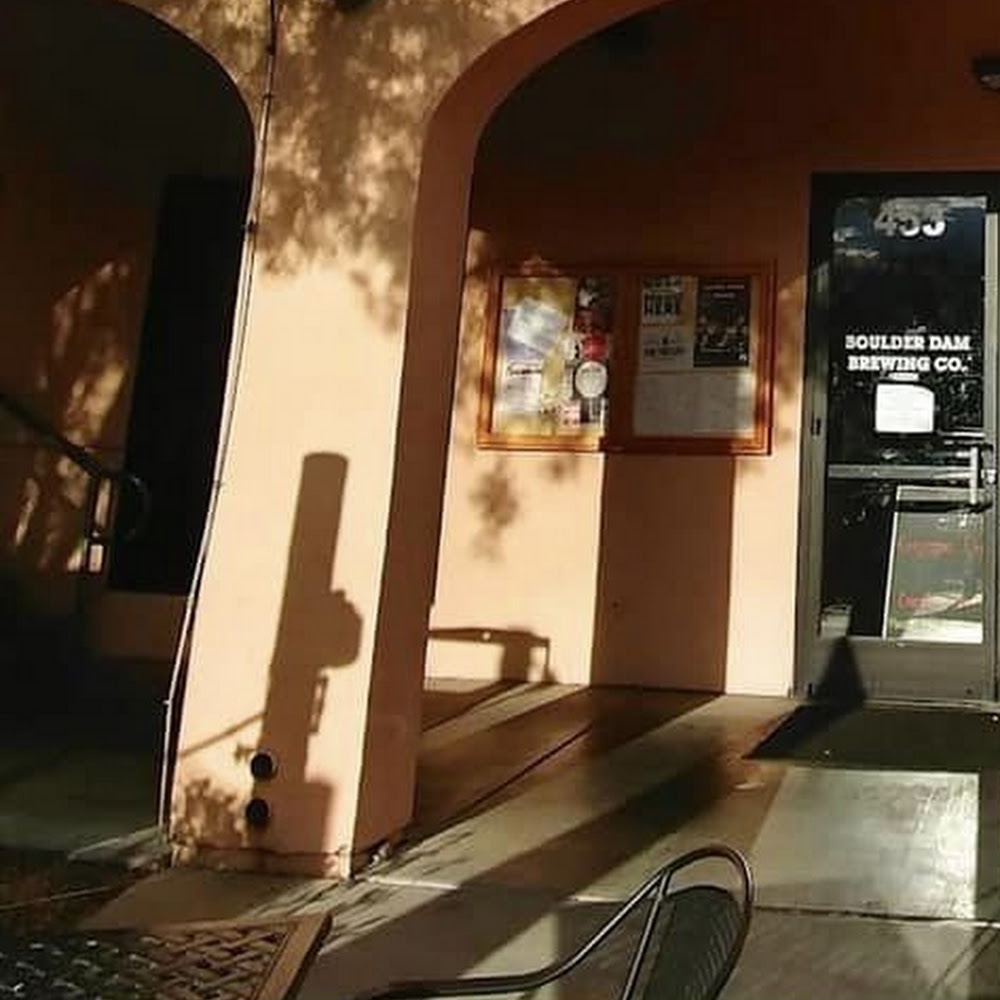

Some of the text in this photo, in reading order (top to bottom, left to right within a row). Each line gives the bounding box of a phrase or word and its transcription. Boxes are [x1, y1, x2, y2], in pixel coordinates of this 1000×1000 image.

[845, 333, 972, 351] BOULDER DAM
[847, 354, 969, 373] BREWING CO.
